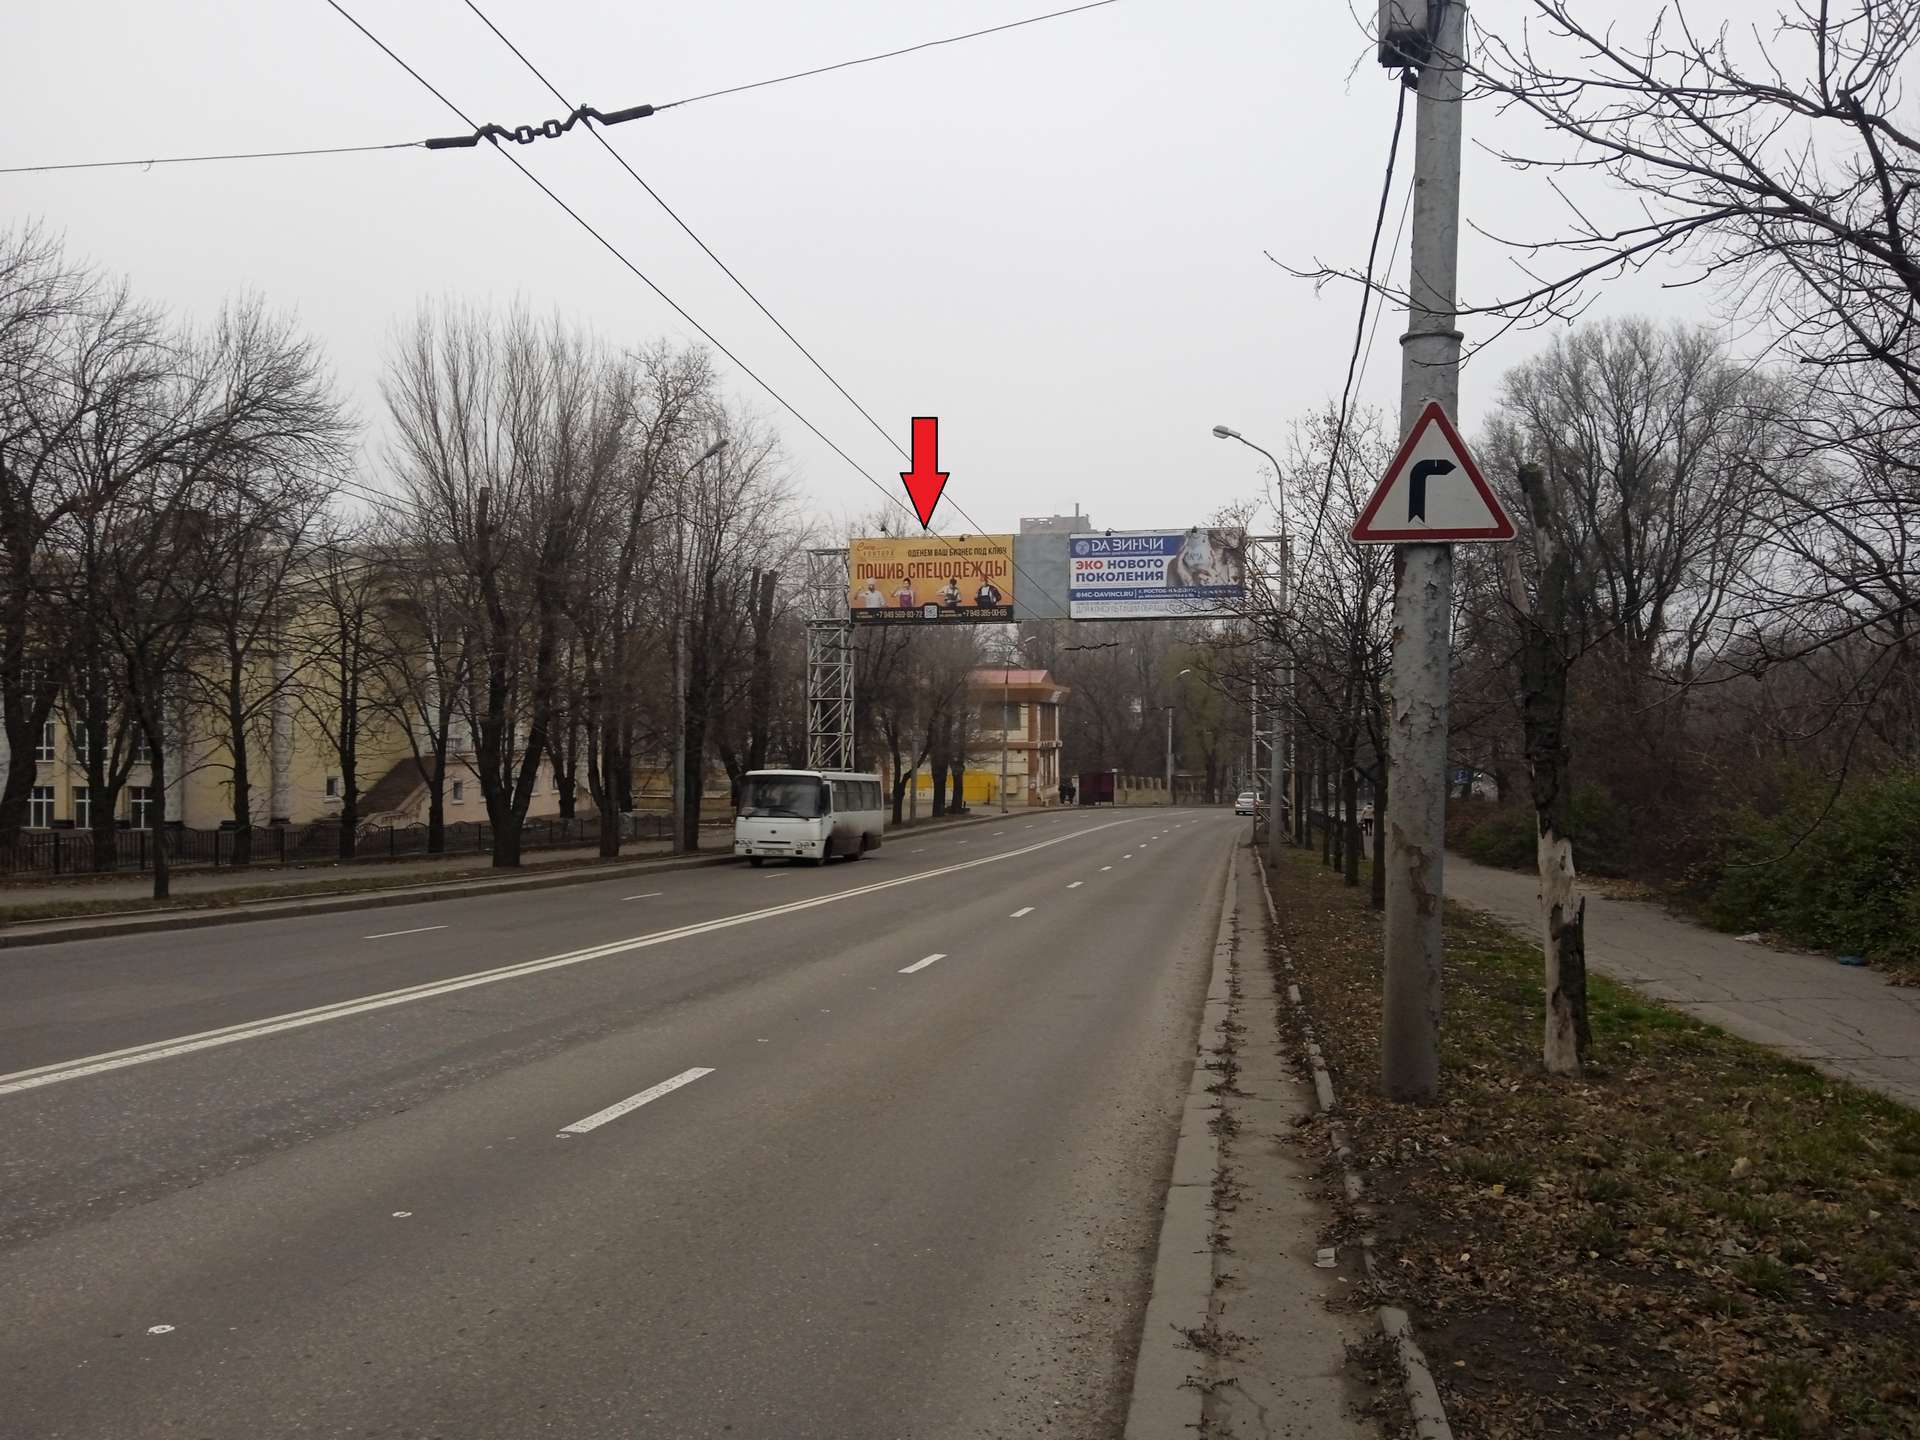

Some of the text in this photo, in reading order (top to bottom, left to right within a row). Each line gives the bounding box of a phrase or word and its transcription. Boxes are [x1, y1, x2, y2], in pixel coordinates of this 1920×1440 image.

[934, 548, 949, 557] ВАШ
[949, 547, 974, 557] БИЗНЕС
[974, 547, 987, 556] ПОД
[856, 559, 1008, 580] ПОШИВ СПЕЦОДЕЖДЫ
[1075, 558, 1164, 570] ЭКО НОВОГО
[1075, 570, 1164, 583] ПОКОЛЕНИЯ
